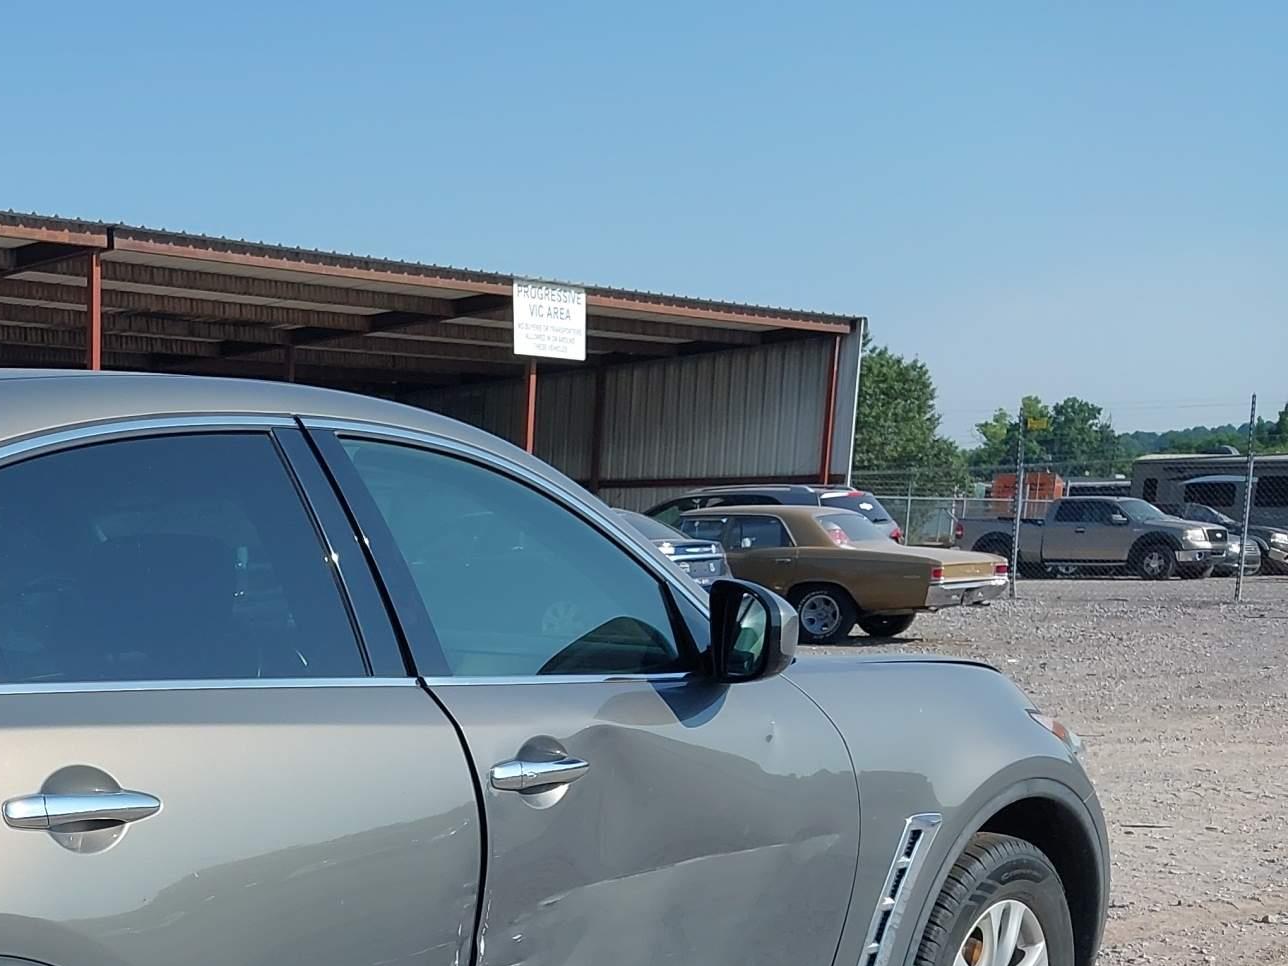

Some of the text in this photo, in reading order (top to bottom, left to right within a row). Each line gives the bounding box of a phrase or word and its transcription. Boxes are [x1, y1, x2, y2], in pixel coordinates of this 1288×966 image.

[517, 284, 582, 305] PROGRESSIVE
[529, 303, 571, 321] VIC AREA
